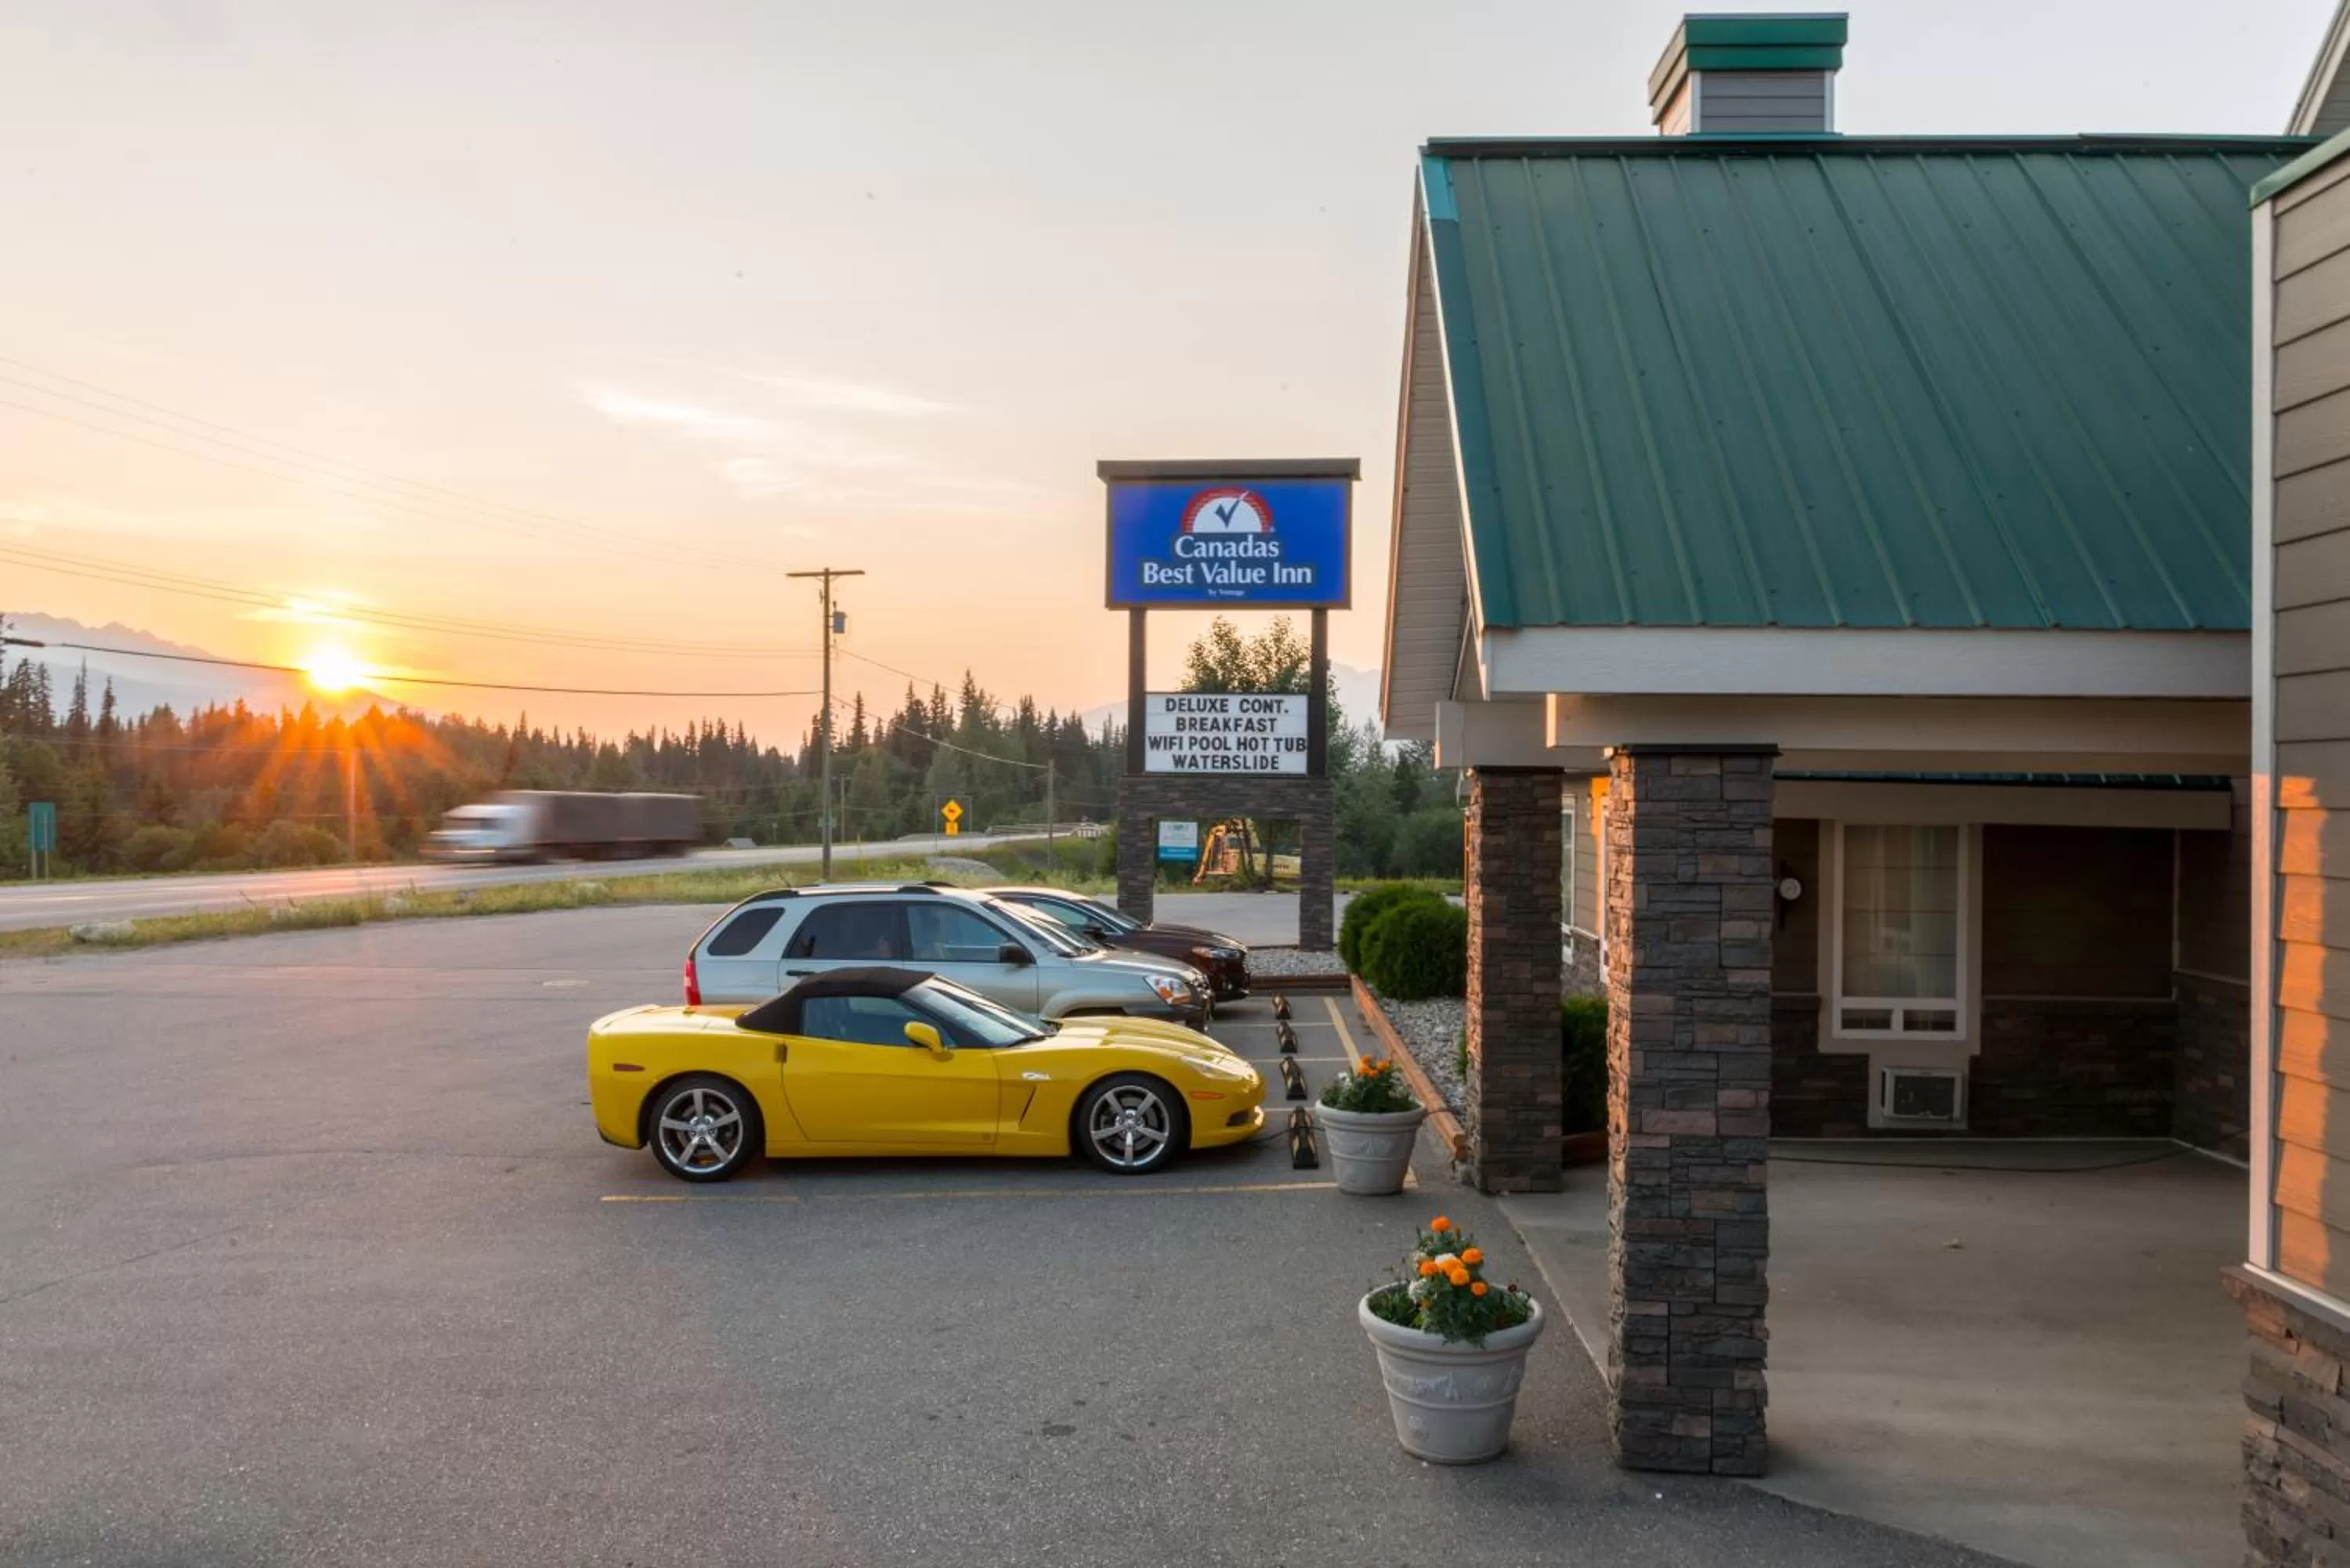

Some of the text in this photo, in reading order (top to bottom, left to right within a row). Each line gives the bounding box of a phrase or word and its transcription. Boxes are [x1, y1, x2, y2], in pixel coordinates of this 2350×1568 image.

[1175, 534, 1279, 558] Canadas
[1143, 560, 1312, 584] Best Value Inn
[1166, 698, 1289, 714] DELUXE CONT.
[1176, 717, 1278, 732] BREAKFAST
[1148, 735, 1307, 752] WIFI POOL HOT TUB
[1172, 754, 1279, 770] WATERSLIDE
